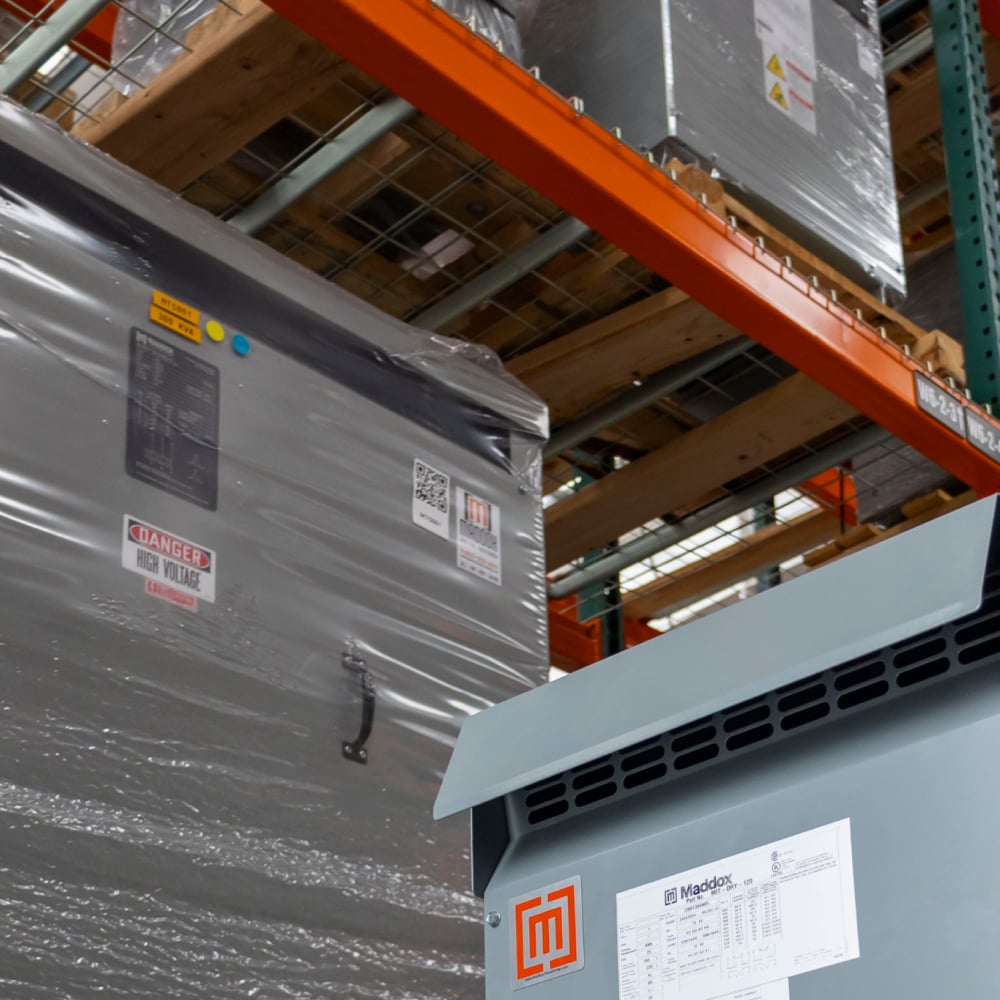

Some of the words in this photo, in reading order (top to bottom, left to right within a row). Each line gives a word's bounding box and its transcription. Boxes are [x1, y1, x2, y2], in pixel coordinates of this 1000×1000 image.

[138, 525, 203, 568] DANGER
[136, 547, 159, 576] HIGH
[162, 556, 202, 594] VOLTAGE
[680, 871, 732, 899] Maddox
